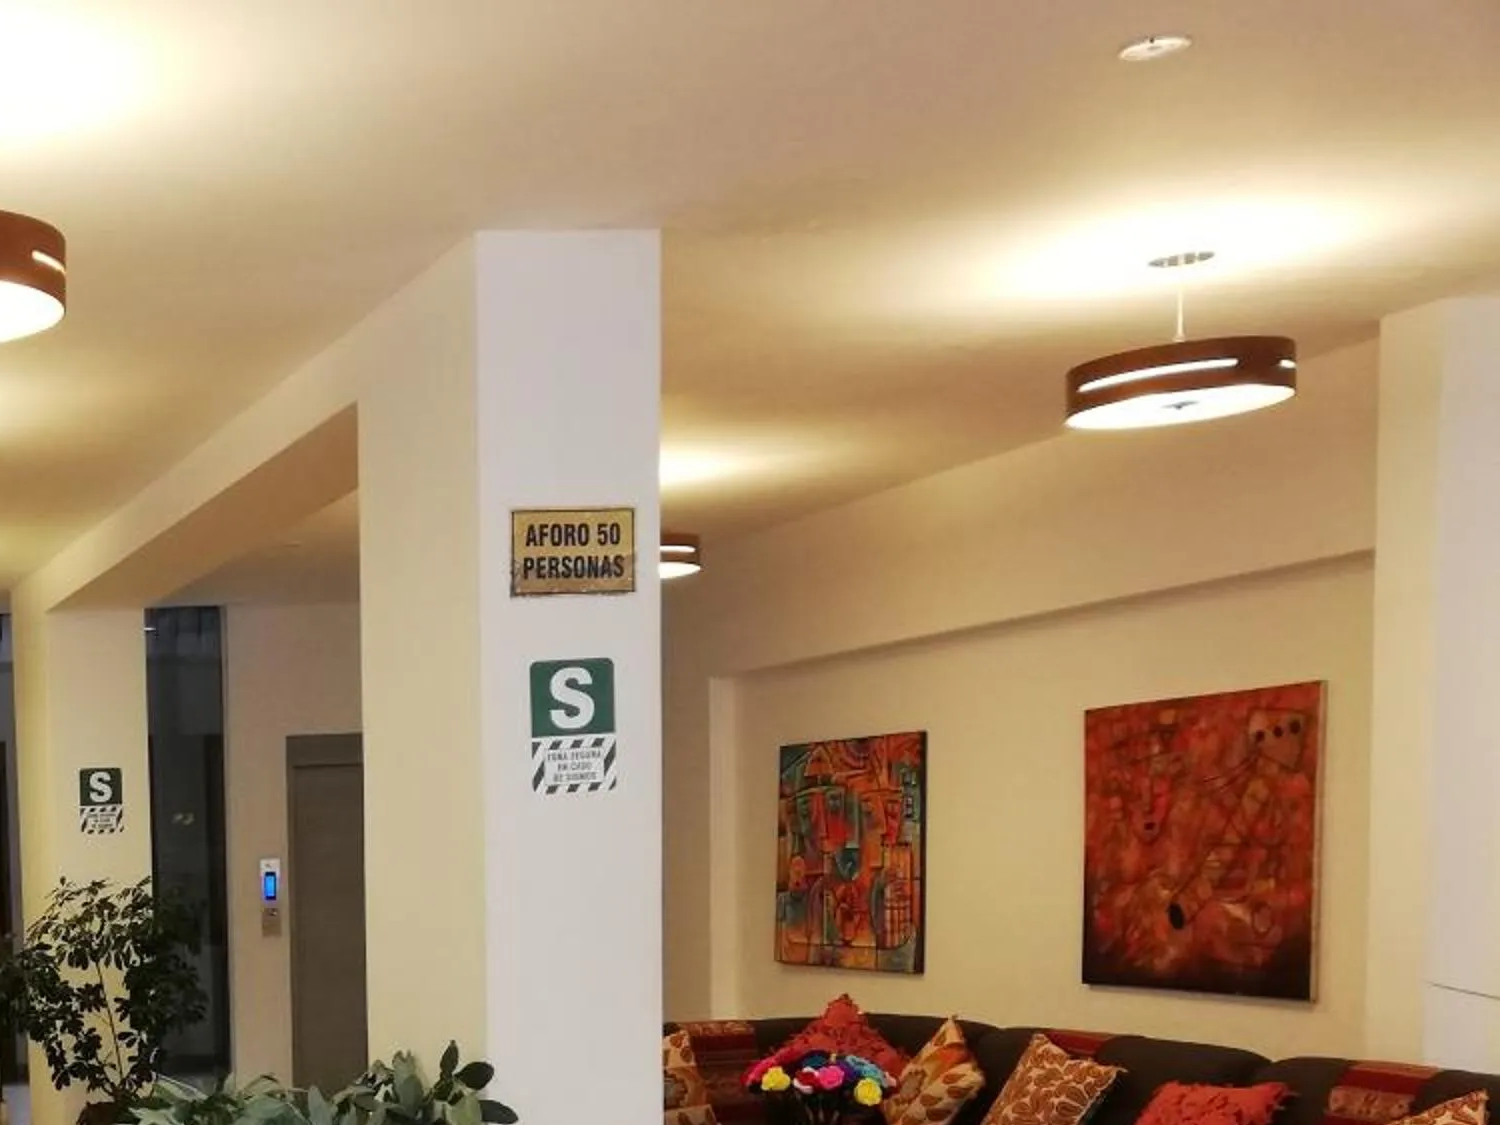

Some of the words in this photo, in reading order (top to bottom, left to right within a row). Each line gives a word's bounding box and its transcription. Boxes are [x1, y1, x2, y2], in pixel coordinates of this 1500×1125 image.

[525, 523, 590, 547] AFORO
[597, 522, 621, 546] 50
[523, 555, 625, 579] PERSONAS
[550, 667, 595, 729] S
[90, 771, 113, 802] S
